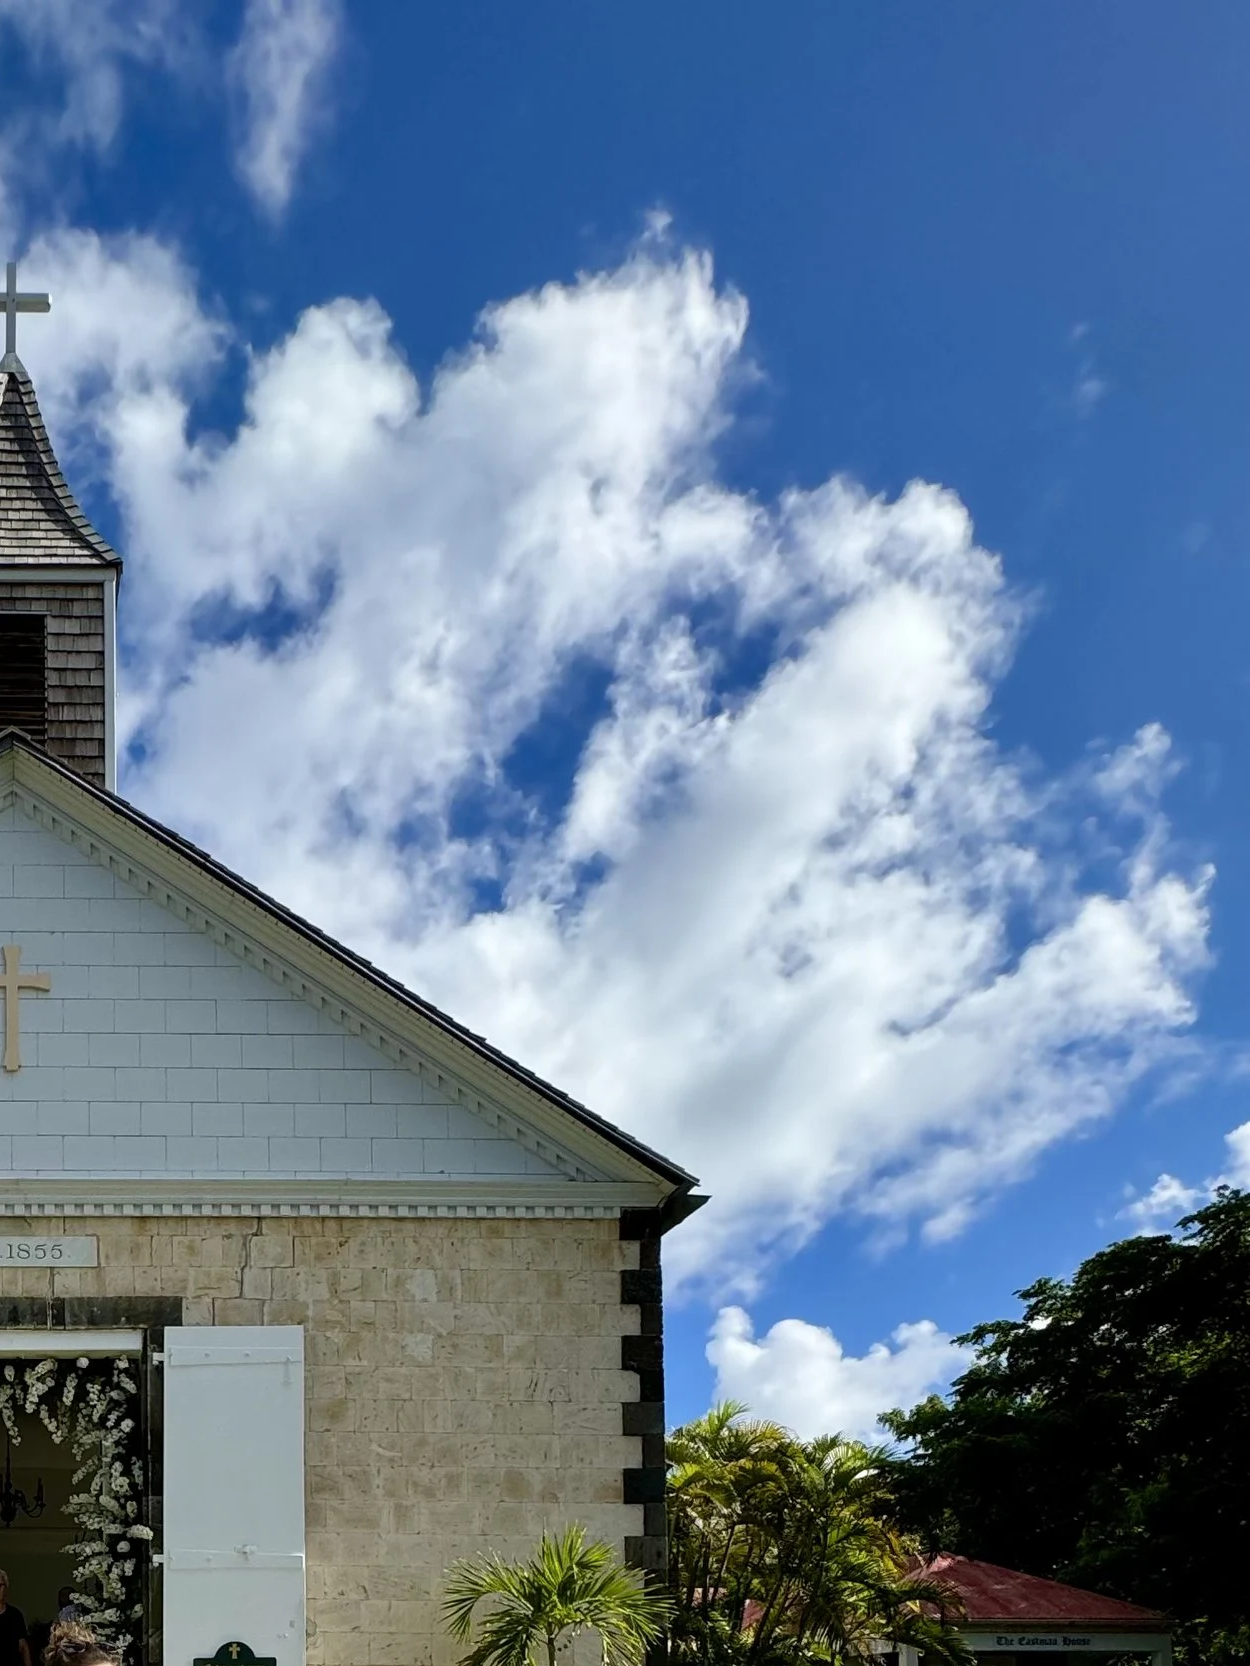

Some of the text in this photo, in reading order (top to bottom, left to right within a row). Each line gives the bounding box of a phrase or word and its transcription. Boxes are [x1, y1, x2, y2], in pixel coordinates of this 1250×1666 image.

[996, 1635, 1091, 1647] The Eastman House
